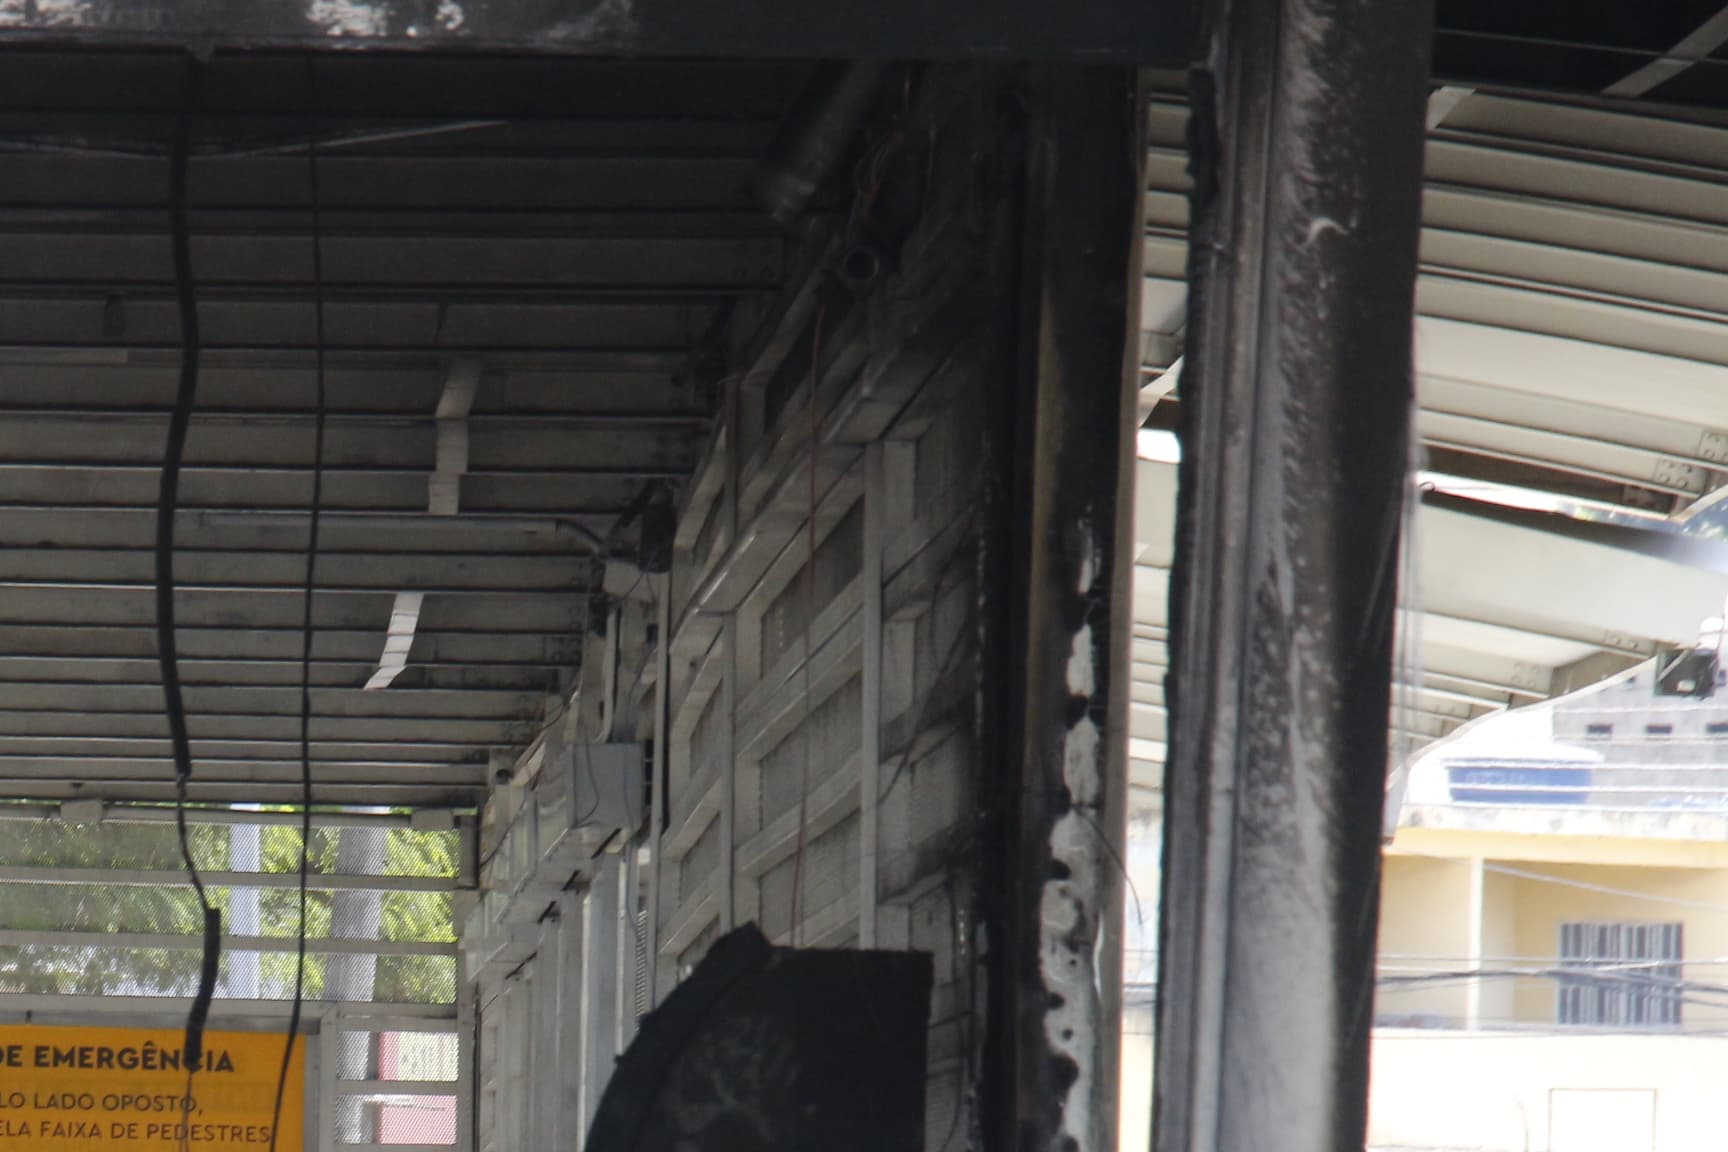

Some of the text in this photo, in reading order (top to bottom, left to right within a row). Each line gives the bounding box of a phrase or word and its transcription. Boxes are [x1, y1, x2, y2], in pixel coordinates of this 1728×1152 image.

[34, 1092, 94, 1110] LADO
[102, 1093, 203, 1116] OPOSTO,
[40, 1120, 103, 1138] FAIXA
[111, 1123, 139, 1140] DE
[147, 1123, 272, 1144] PEDESTRES
